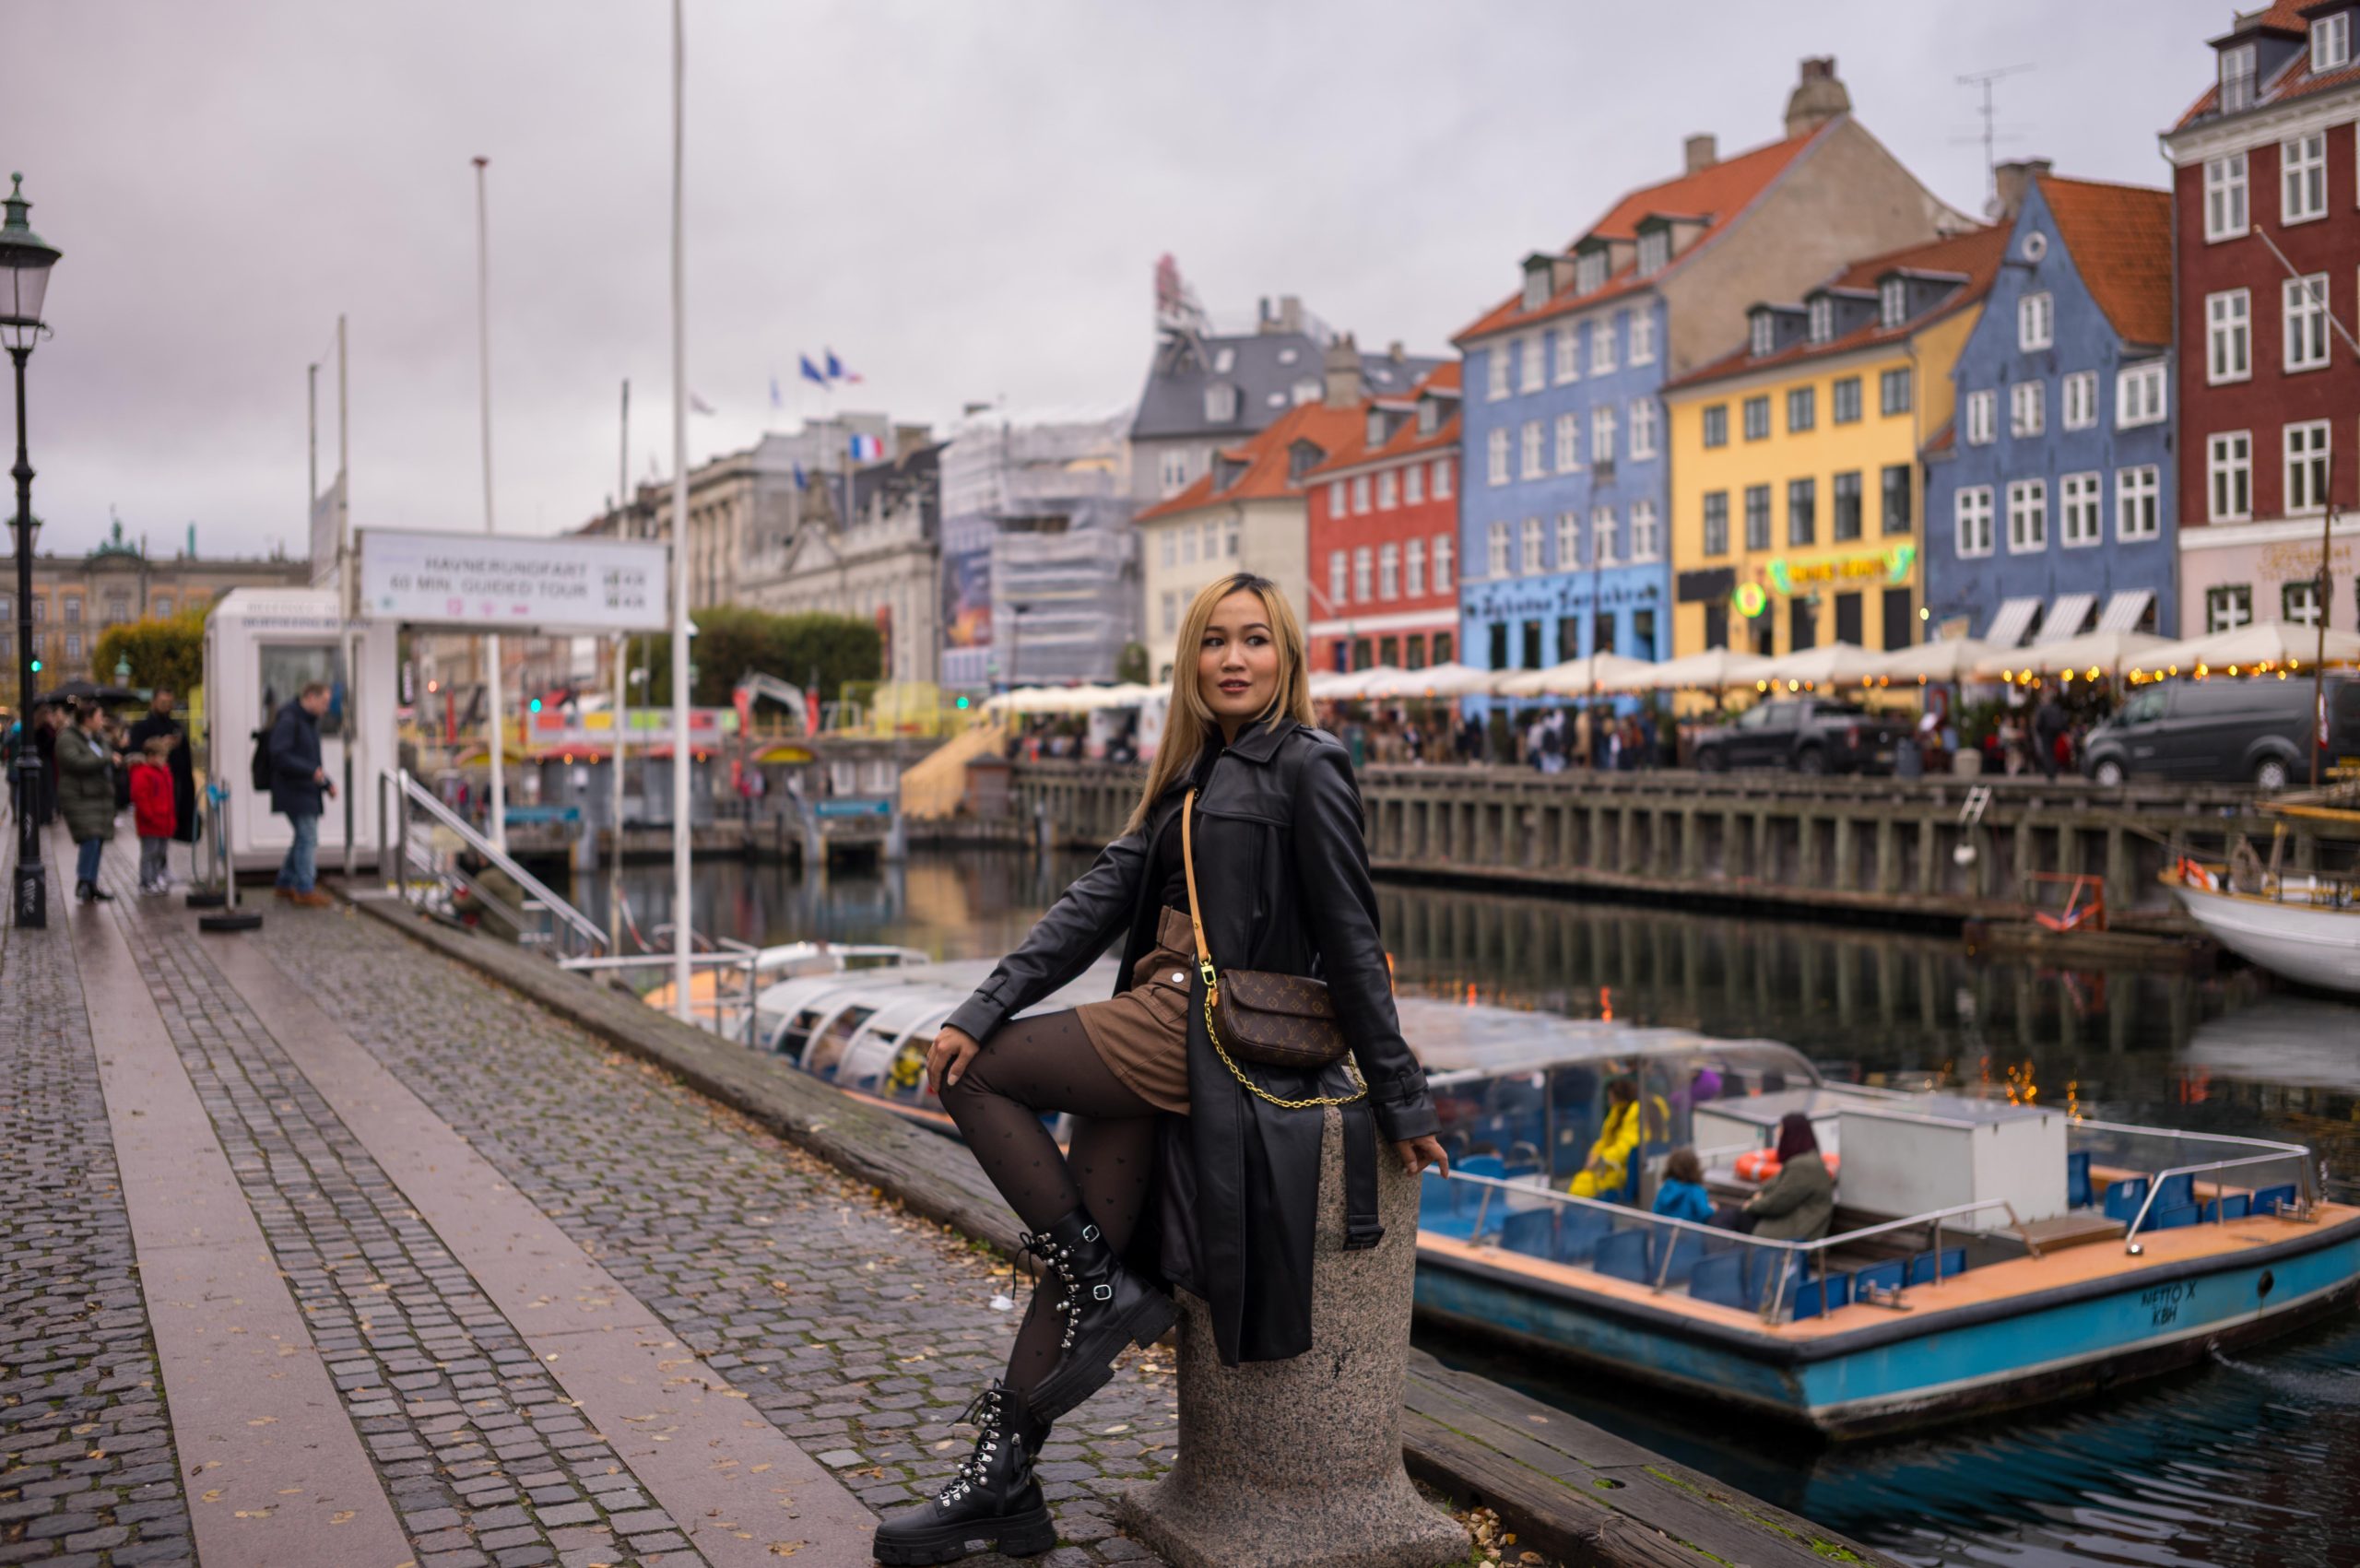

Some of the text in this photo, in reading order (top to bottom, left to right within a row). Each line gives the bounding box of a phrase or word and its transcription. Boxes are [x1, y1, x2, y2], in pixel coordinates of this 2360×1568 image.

[425, 556, 587, 577] HAVNERUNDFART
[461, 577, 533, 596] GUIDED
[538, 581, 587, 597] TOUR
[2142, 1280, 2198, 1306] NETTO X
[2152, 1306, 2177, 1327] KBH
